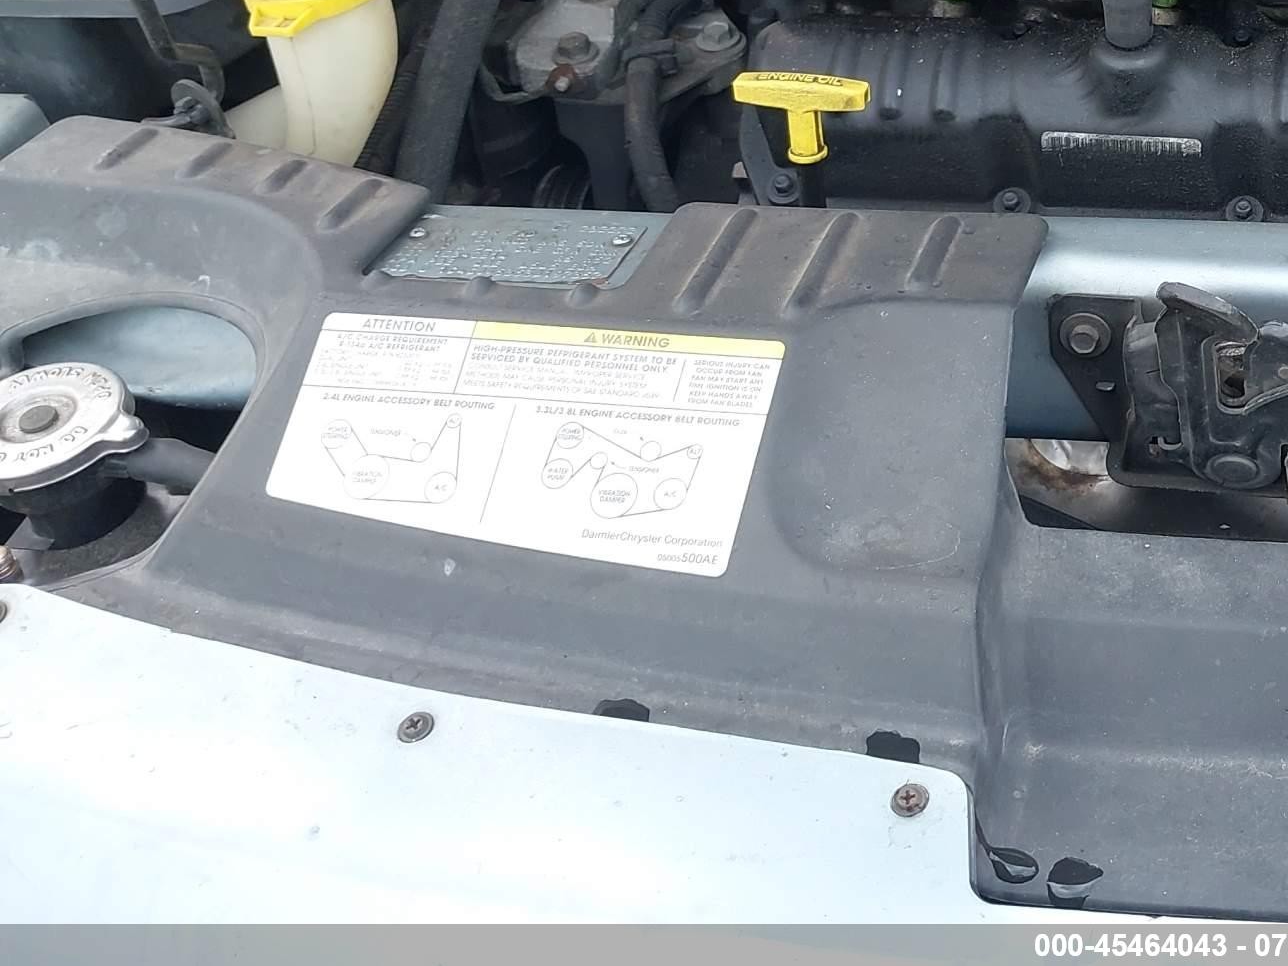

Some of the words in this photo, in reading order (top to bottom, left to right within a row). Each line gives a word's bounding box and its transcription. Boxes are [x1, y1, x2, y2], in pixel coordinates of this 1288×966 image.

[757, 73, 814, 83] ENGINE
[816, 76, 844, 87] OIL
[362, 318, 437, 332] ATTENTION
[391, 335, 449, 346] REQUIREMENT
[601, 333, 671, 348] WARNING
[471, 353, 516, 363] SERVICED
[518, 355, 530, 364] BY
[532, 356, 582, 368] QUALIFIED
[584, 360, 639, 372] PERSONNEL
[642, 364, 670, 374] ONLY
[473, 344, 545, 356] HIGH-PRESSURE
[547, 349, 610, 361] REFRIGERANT
[613, 353, 649, 364] SYSTEM
[651, 356, 663, 365] TO
[665, 357, 677, 366] BE
[753, 363, 771, 371] CAN
[322, 392, 341, 401] 2.4L
[343, 393, 376, 404] ENGINE
[377, 396, 432, 407] ACCESSORY
[433, 398, 453, 408] BELT
[454, 399, 496, 411] ROUTING
[579, 409, 614, 420] ENGINE
[615, 410, 673, 423] ACCESSORY
[674, 415, 695, 425] BELT
[697, 417, 741, 428] ROUTING
[581, 528, 663, 545] DaimlerChrysler
[664, 534, 723, 548] Corporation
